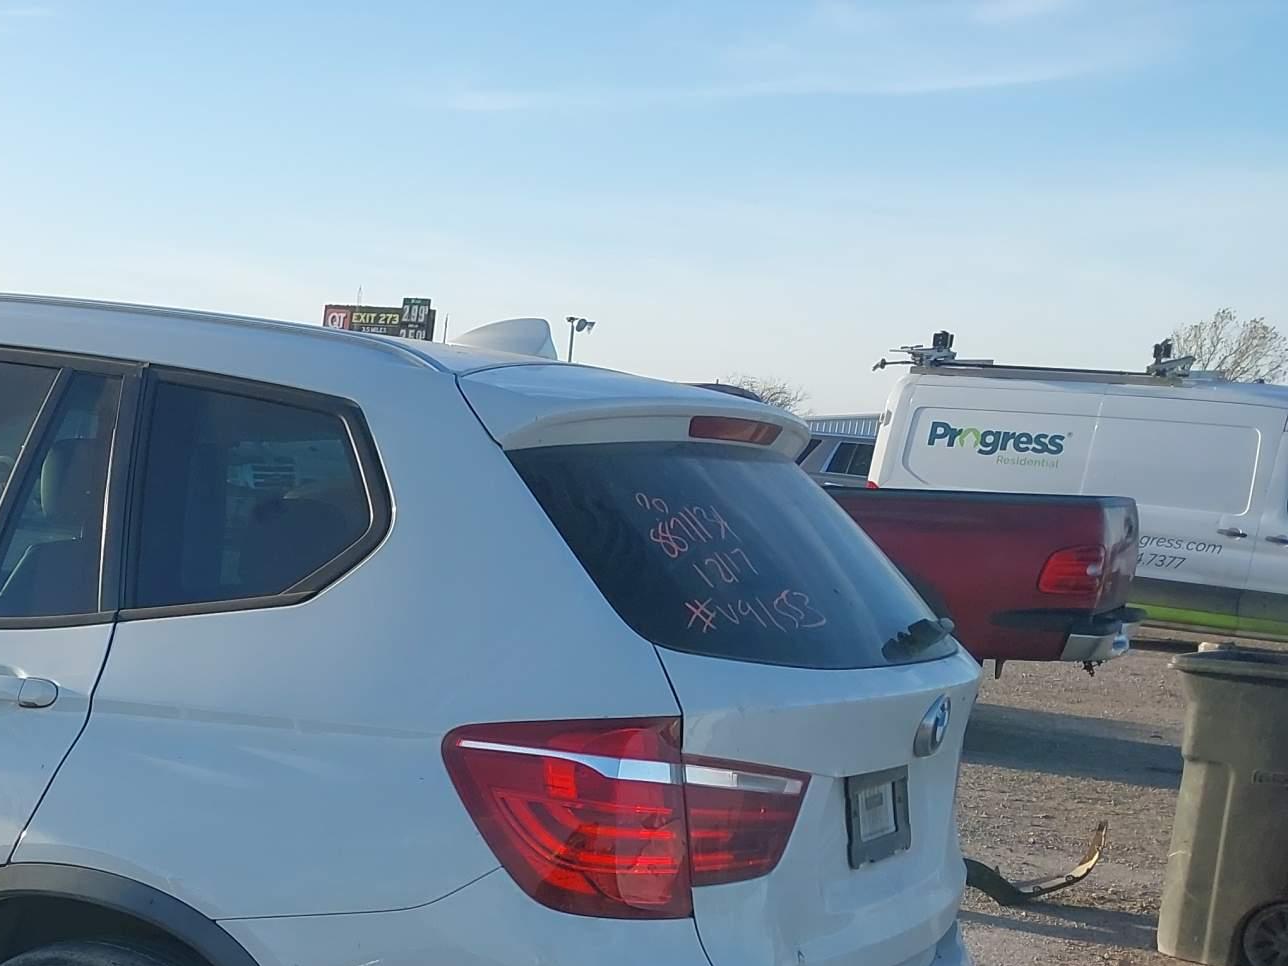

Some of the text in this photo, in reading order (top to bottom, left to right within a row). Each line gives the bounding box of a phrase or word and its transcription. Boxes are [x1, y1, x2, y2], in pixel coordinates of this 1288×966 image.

[328, 312, 346, 329] QT
[352, 312, 400, 325] EXIT 273
[927, 421, 1065, 456] Progress
[996, 455, 1059, 469] Residential
